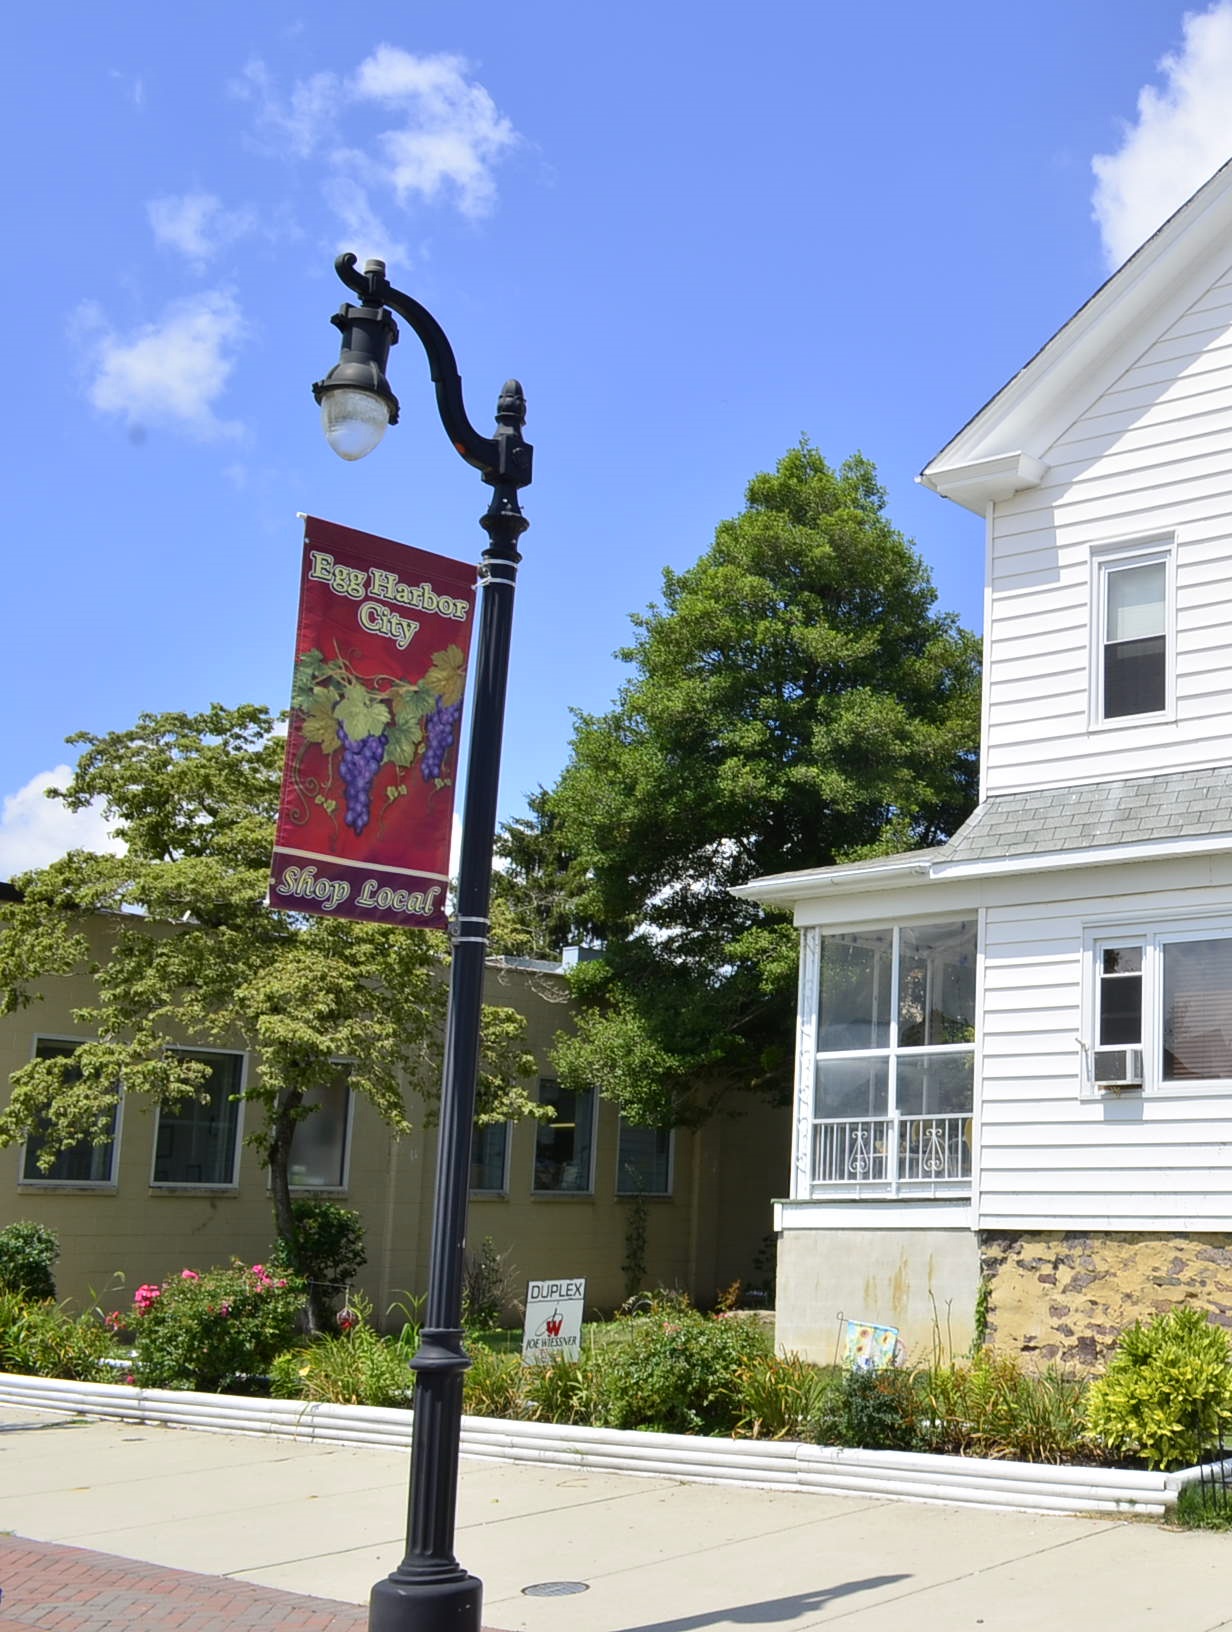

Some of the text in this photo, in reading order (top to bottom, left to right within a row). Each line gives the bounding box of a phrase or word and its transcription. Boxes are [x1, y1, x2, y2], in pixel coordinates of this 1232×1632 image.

[309, 551, 470, 621] Egg Harbor
[358, 601, 419, 649] City
[276, 866, 442, 916] Shop Local
[530, 1282, 583, 1299] DUPLEX
